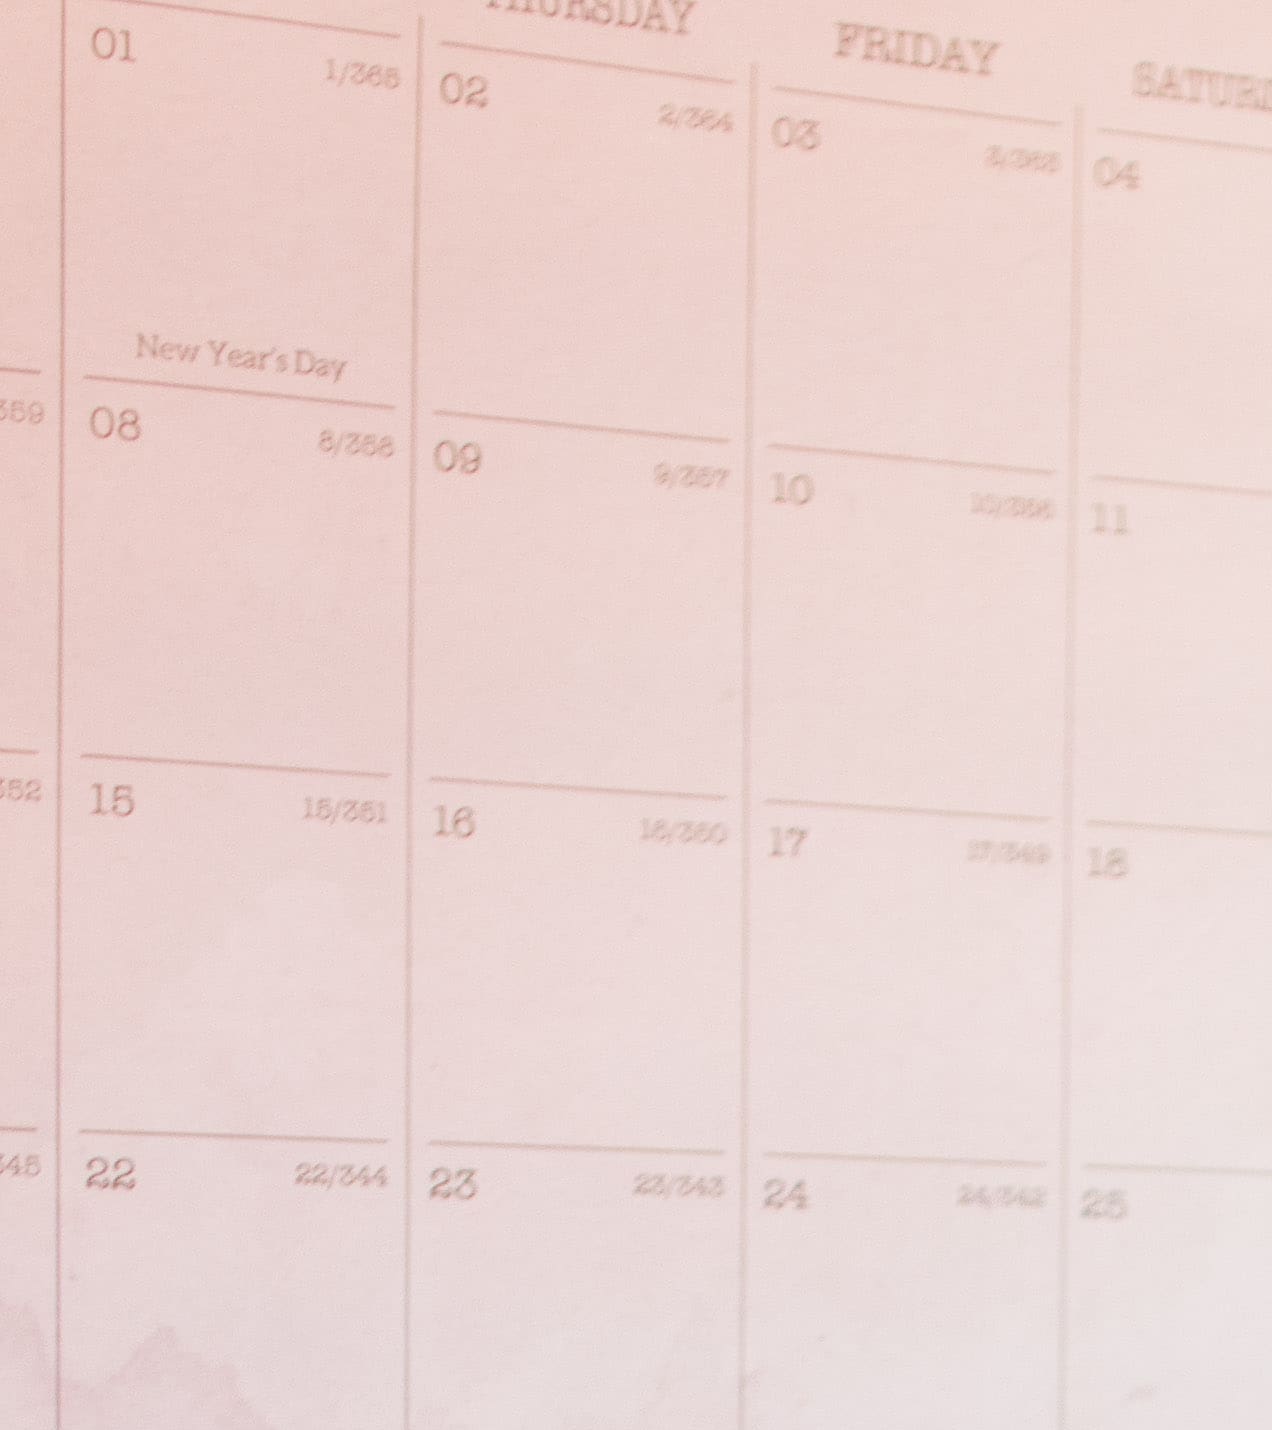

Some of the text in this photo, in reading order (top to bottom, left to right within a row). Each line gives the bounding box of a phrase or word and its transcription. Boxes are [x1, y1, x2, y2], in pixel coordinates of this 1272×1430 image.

[90, 28, 136, 62] 01
[834, 22, 1001, 77] FRIDAY
[438, 71, 489, 109] 02
[770, 116, 822, 151] 03
[1091, 156, 1142, 190] 04
[135, 333, 348, 383] New Year's Day
[89, 406, 142, 442] 08
[433, 439, 483, 474] 09
[770, 473, 815, 506] 10
[1091, 503, 1132, 536] 11
[89, 783, 136, 818] 15
[432, 805, 477, 840] 16
[767, 826, 808, 858] 17
[1086, 847, 1129, 880] 18
[85, 1156, 136, 1191] 22
[428, 1166, 478, 1201] 23
[764, 1178, 809, 1210] 24
[1081, 1188, 1128, 1220] 25
